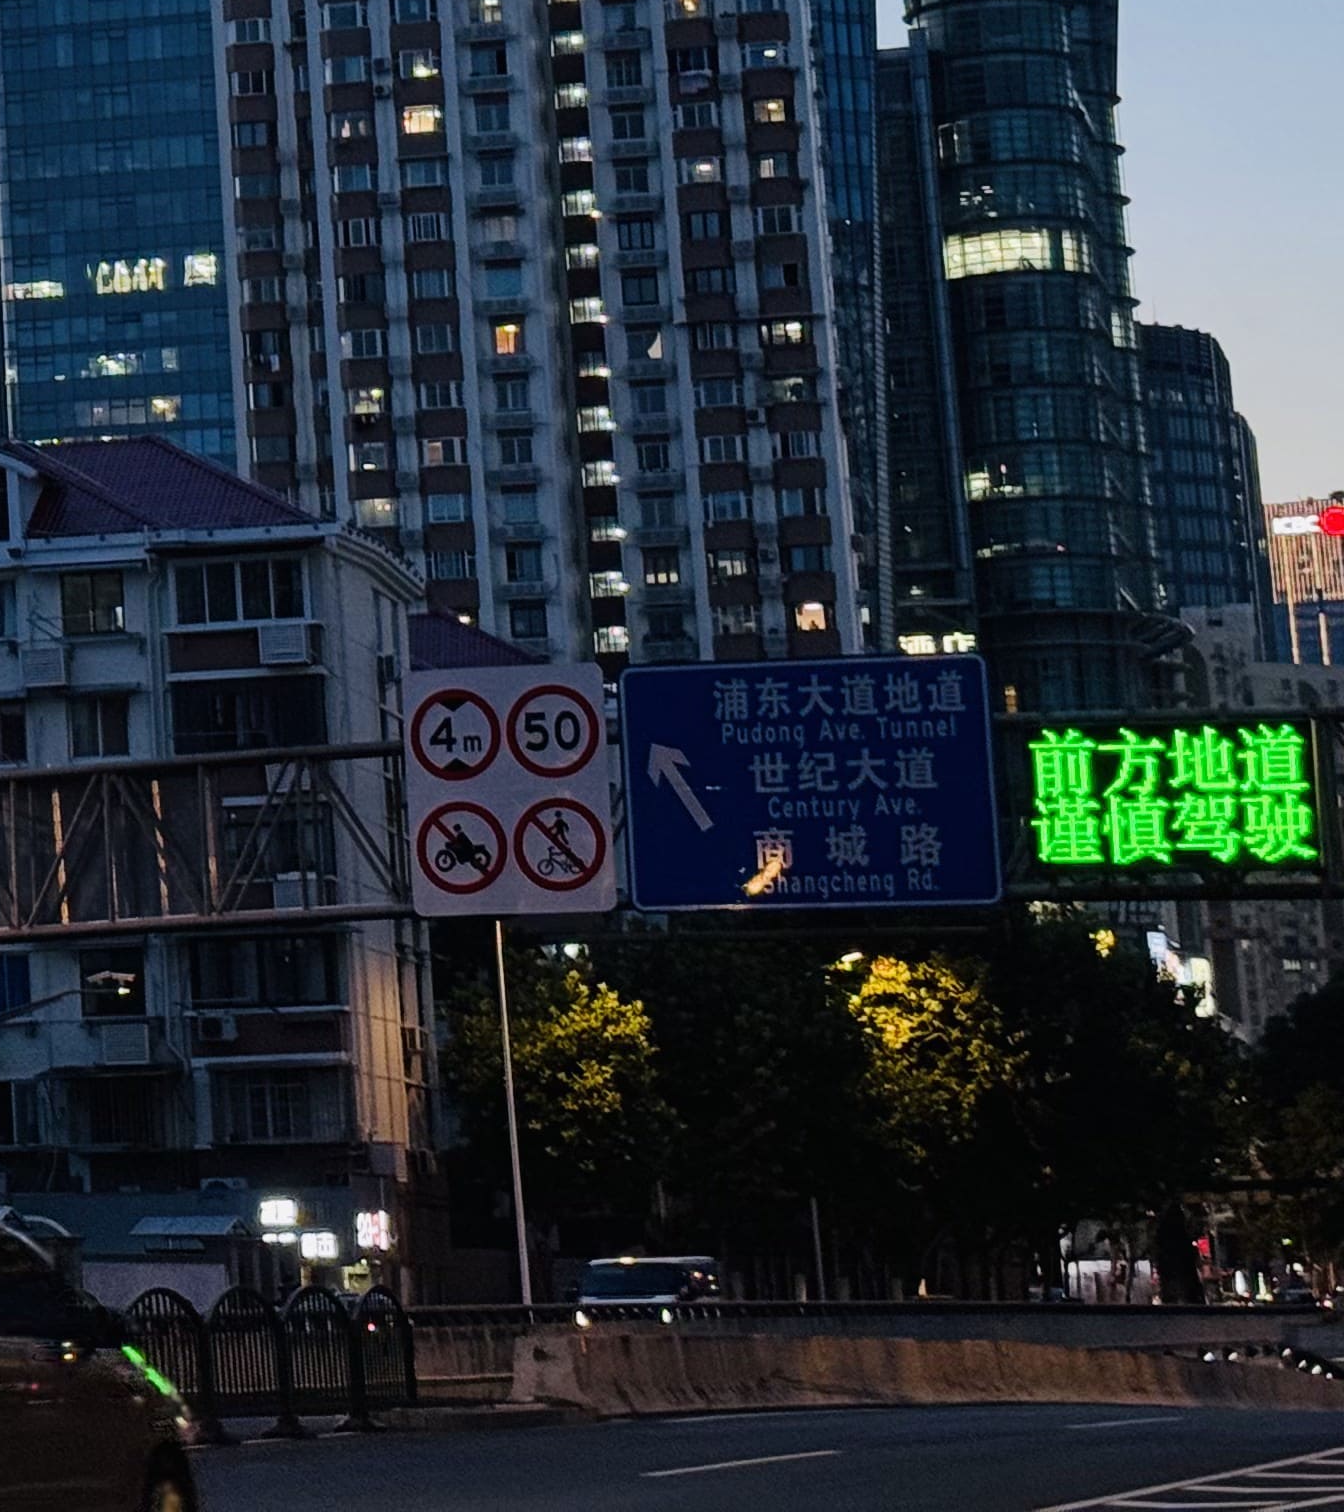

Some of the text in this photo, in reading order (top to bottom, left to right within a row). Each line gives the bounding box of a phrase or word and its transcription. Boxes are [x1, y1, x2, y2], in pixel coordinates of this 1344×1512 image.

[713, 670, 967, 721] 浦东大道地道
[524, 710, 581, 752] 50
[721, 715, 957, 749] Pudong Ave. Tunnel
[748, 747, 939, 793] 世纪大道
[1028, 724, 1311, 797] 前方地道
[768, 794, 923, 820] Century Ave.
[1030, 791, 1318, 865] 谨慎驾驶
[753, 823, 943, 869] 商城路
[907, 868, 940, 891] Rd.
